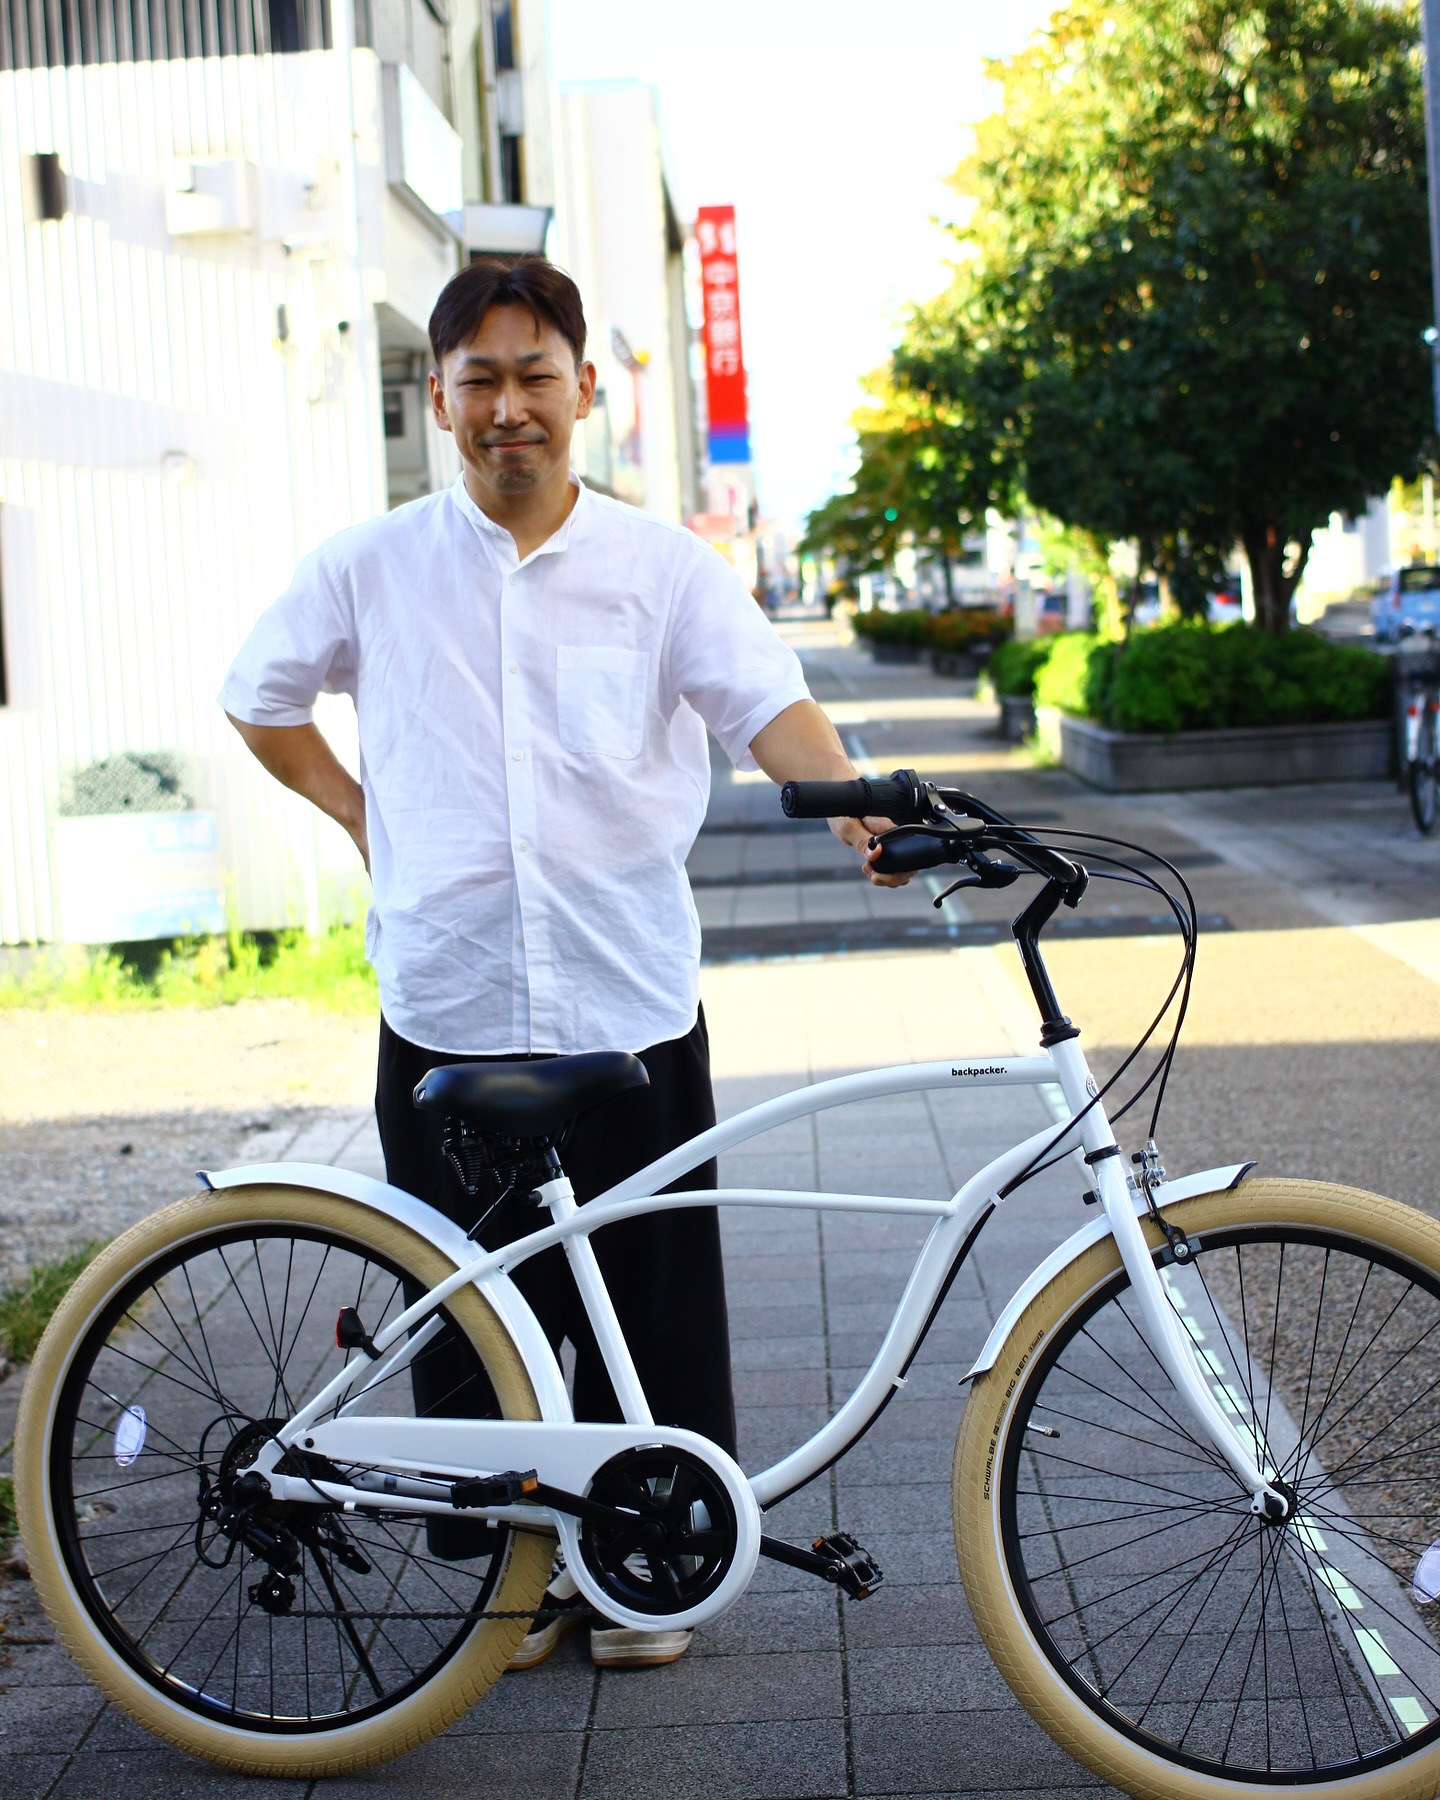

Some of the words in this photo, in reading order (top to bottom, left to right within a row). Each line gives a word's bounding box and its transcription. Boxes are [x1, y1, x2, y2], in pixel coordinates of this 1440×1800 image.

[951, 1066, 1008, 1077] backpacker.
[983, 1439, 997, 1501] SCHWALBE
[1005, 1379, 1016, 1397] BIG
[1015, 1354, 1029, 1377] BEN
